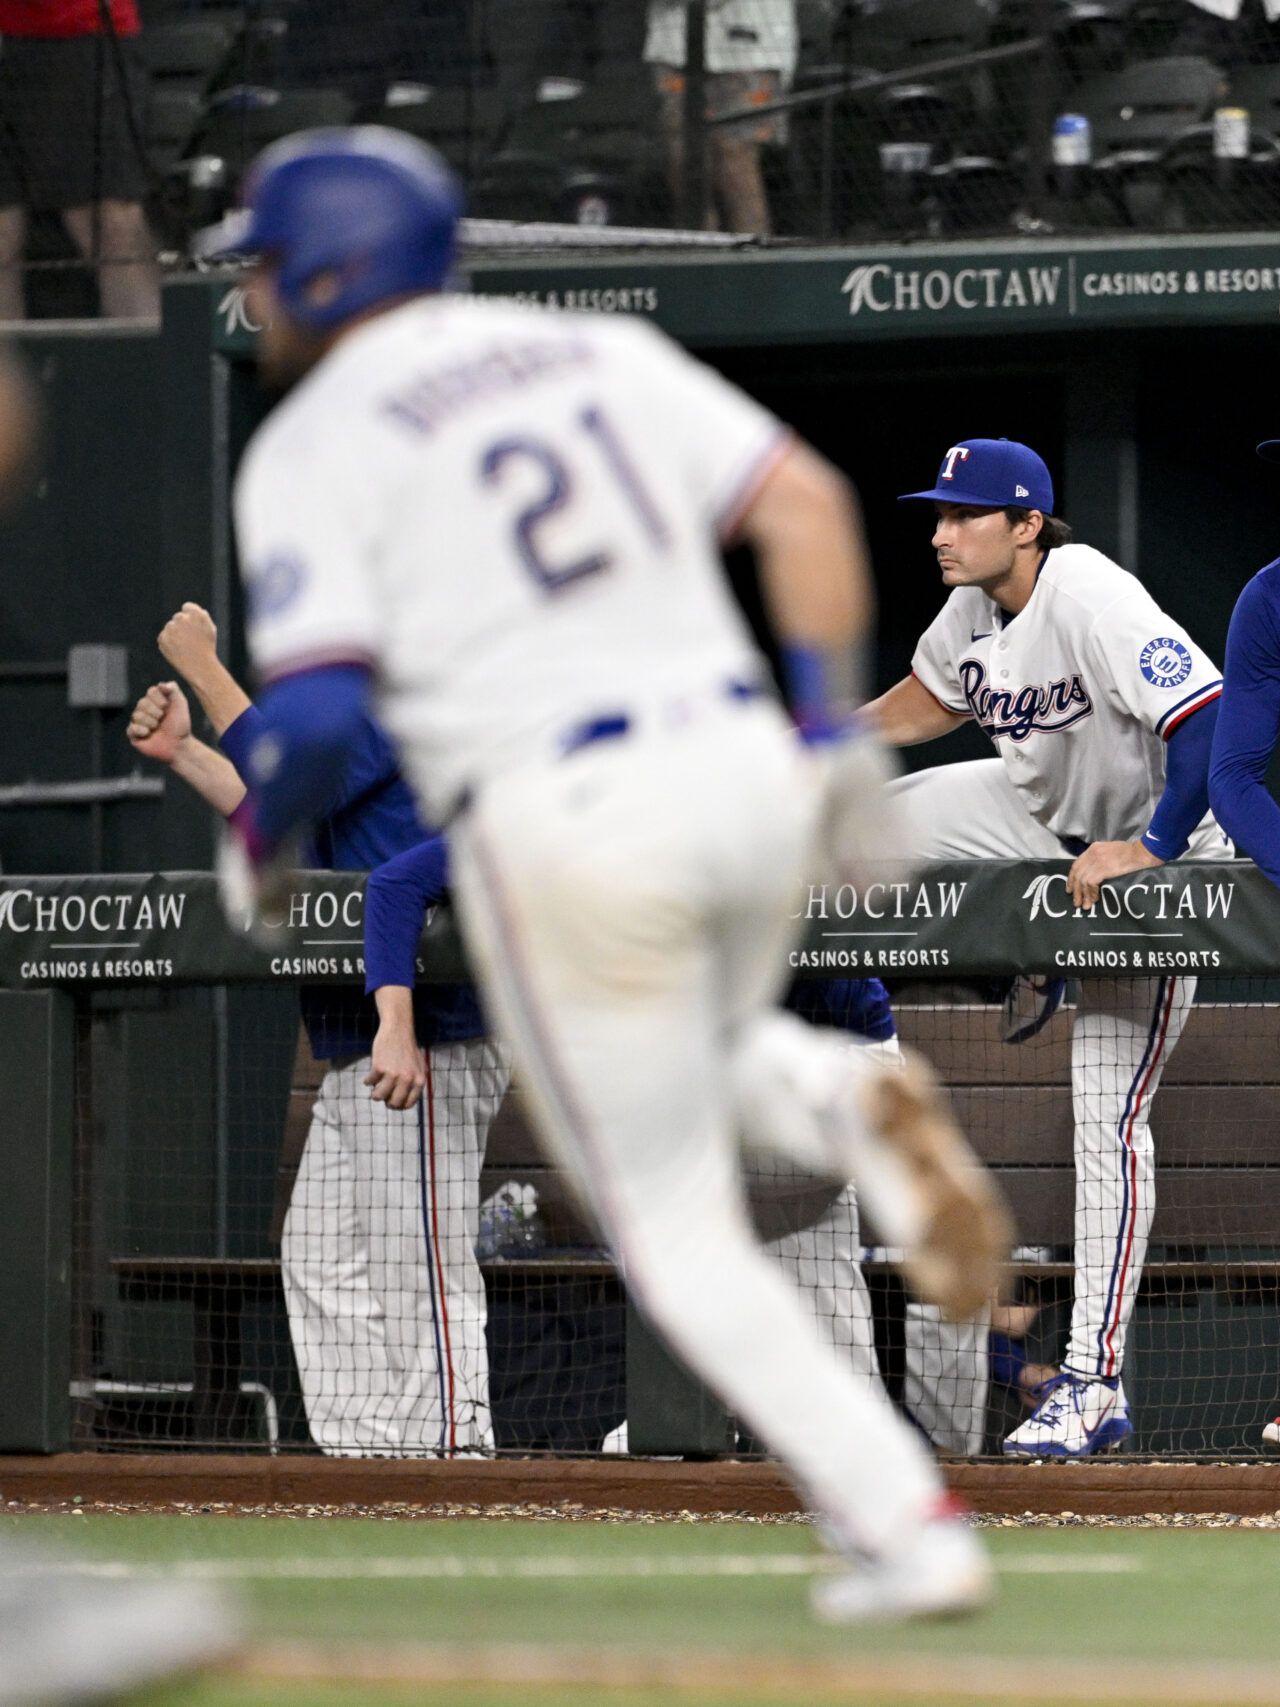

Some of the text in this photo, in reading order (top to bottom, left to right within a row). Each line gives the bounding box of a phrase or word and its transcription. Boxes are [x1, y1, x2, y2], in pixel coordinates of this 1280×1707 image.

[863, 263, 1062, 312] CHOCTAW
[1083, 270, 1180, 297] CASINOS
[1184, 270, 1199, 293] &
[564, 286, 658, 312] RESORTS
[942, 446, 970, 480] T
[478, 404, 674, 592] 21
[1141, 638, 1179, 668] ENERGY
[1150, 651, 1190, 687] TRANSFER
[7, 889, 186, 932] CHOCTAW
[1042, 874, 1235, 919] COCTAW
[21, 959, 173, 978] CASINOS & RESORTS
[270, 957, 338, 975] CASINOS
[342, 957, 354, 974] &
[789, 949, 949, 967] CASINOS & RESORTS
[1055, 950, 1220, 967] CASINOS & RESORTS
